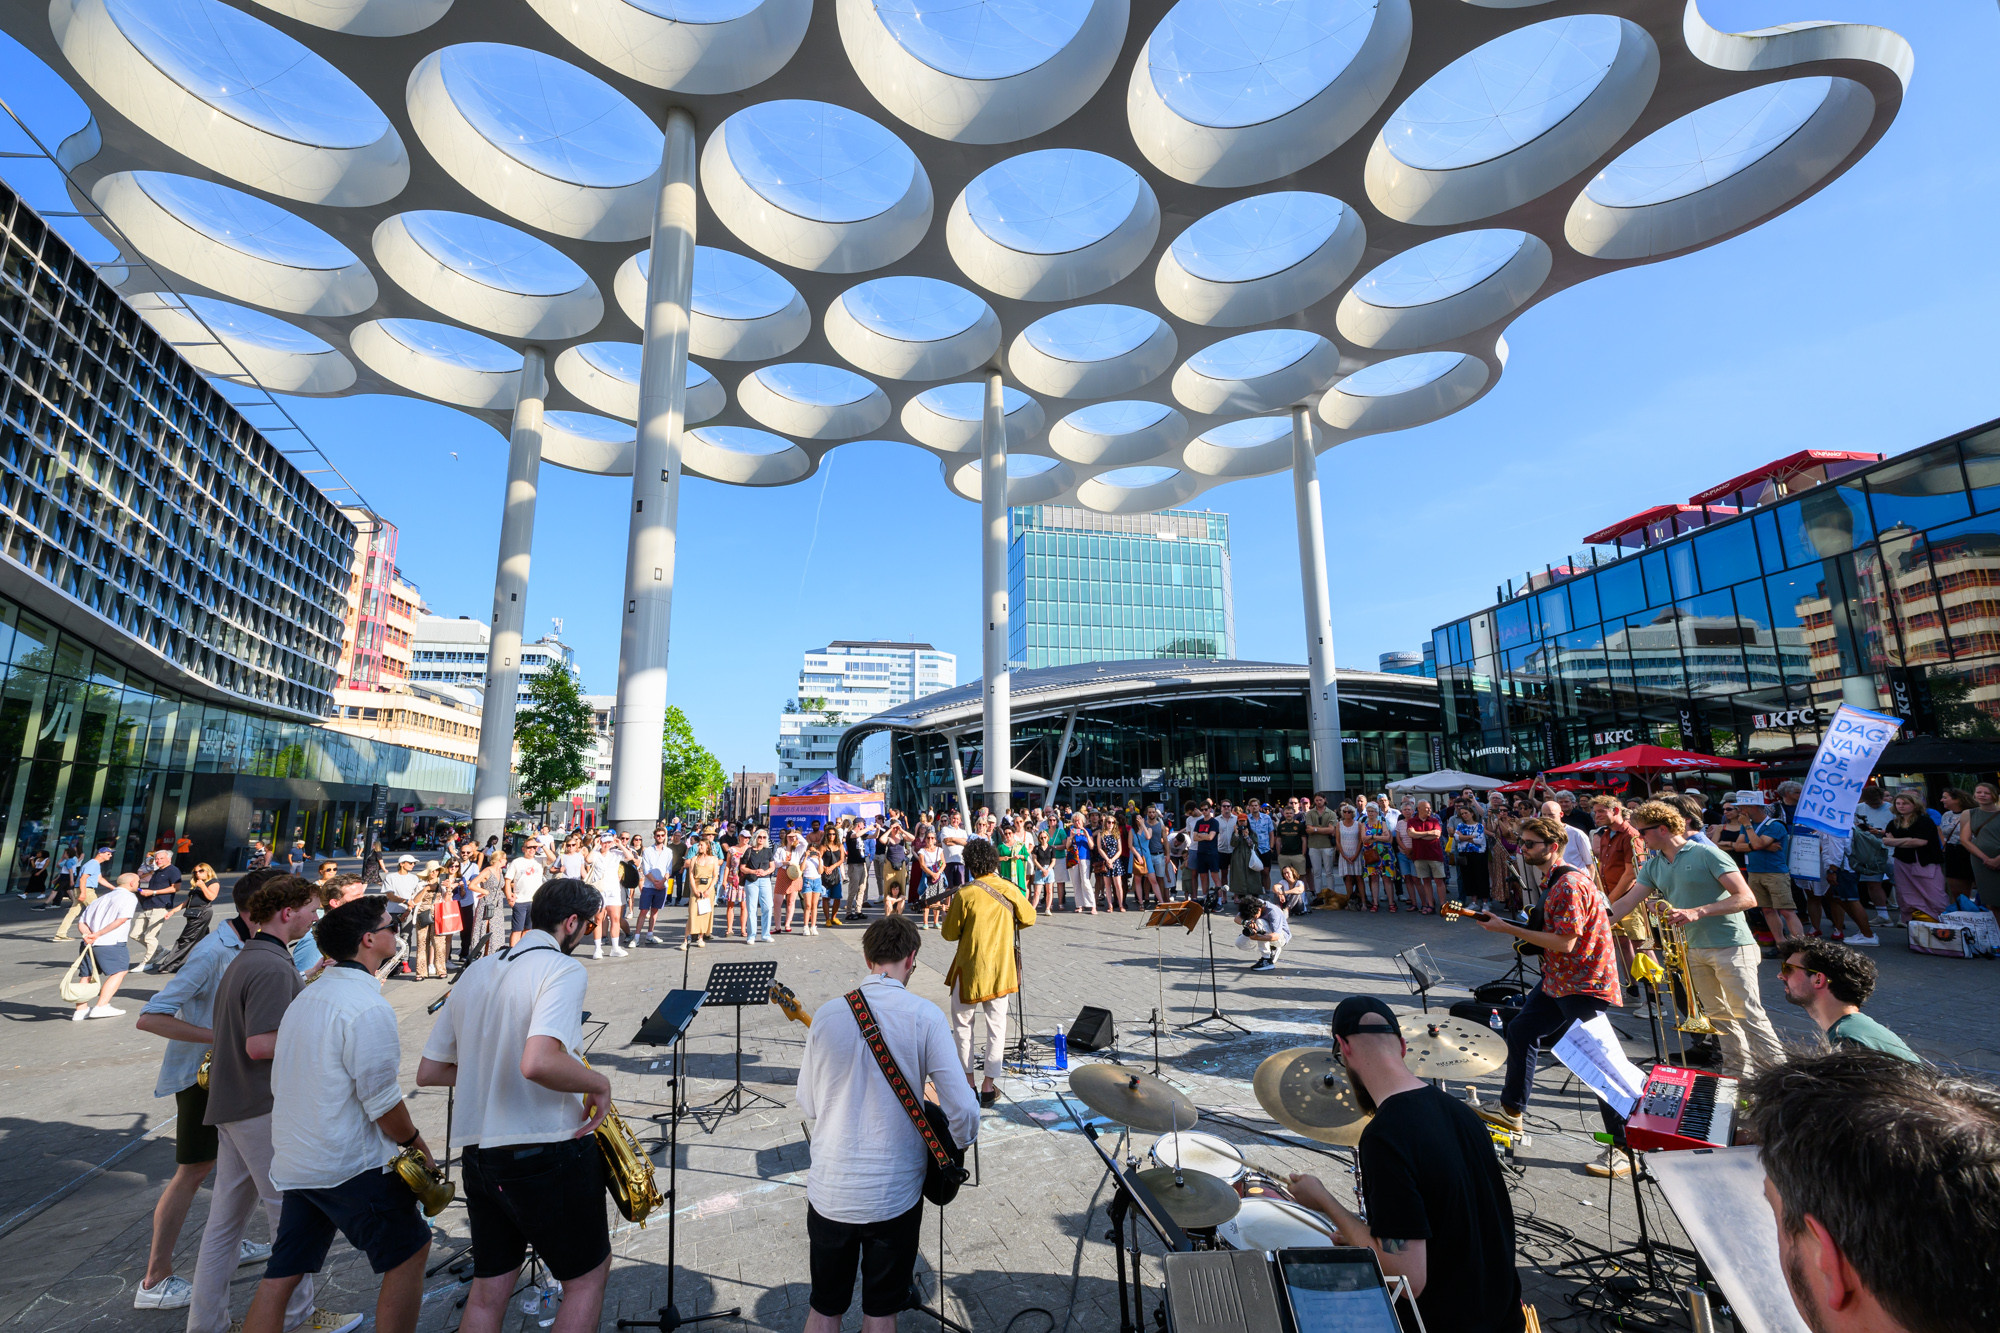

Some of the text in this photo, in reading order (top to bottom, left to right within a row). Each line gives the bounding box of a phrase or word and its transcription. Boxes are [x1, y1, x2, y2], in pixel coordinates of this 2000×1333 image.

[1701, 482, 1732, 498] VAPIANO
[1894, 681, 1911, 716] KFC
[1680, 710, 1694, 737] KFC
[1769, 708, 1815, 728] KFC
[1604, 729, 1634, 744] KFC
[1835, 719, 1885, 742] DAG
[1831, 736, 1873, 758] VAN
[1662, 757, 1720, 766] KFC
[1821, 751, 1850, 771] DE
[1086, 776, 1135, 787] Utrecht
[1814, 768, 1863, 793] COM
[1806, 784, 1836, 803] PO
[1802, 799, 1851, 824] NIST
